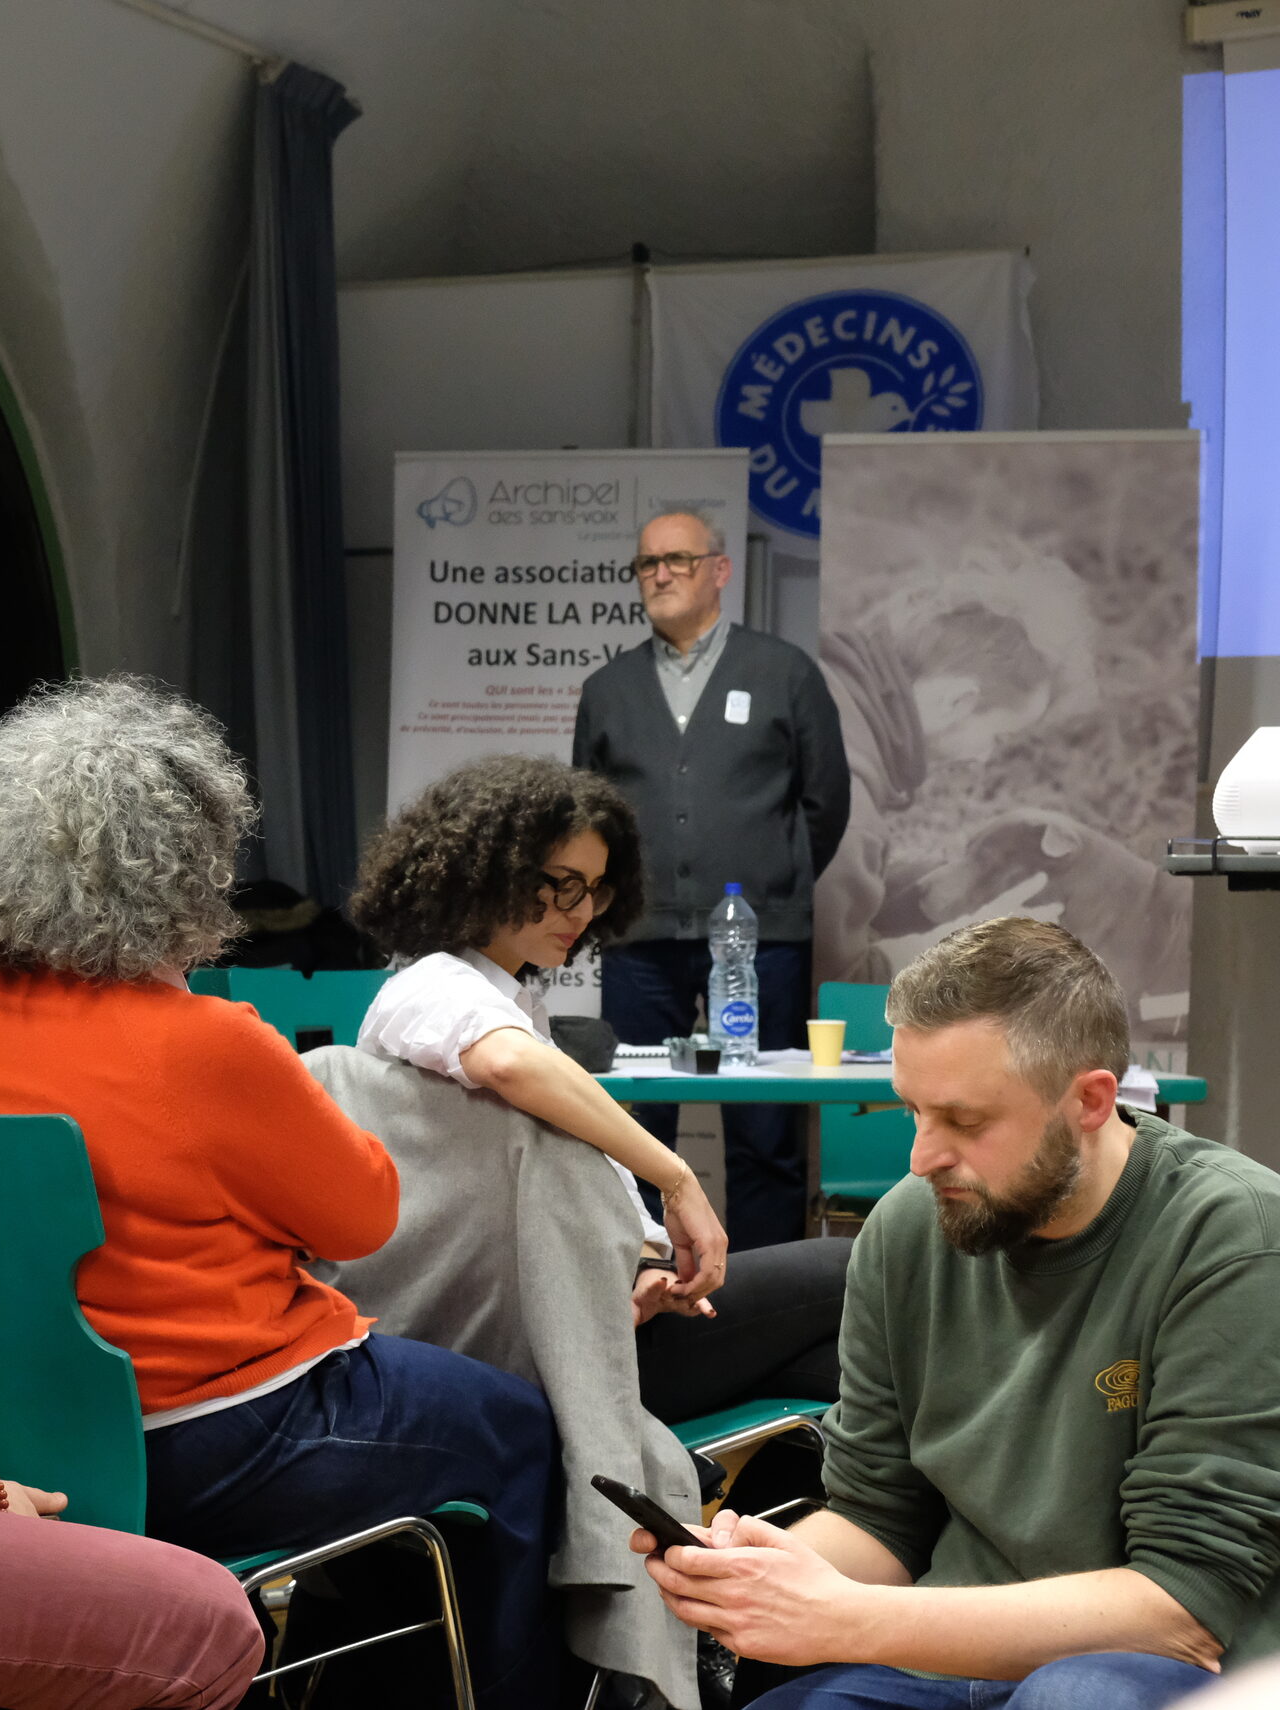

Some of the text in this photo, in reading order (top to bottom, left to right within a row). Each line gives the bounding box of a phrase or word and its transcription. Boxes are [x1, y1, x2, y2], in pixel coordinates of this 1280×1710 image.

[737, 310, 940, 421] MÉDECINS
[749, 444, 799, 499] DU
[488, 478, 620, 508] Archipel
[489, 509, 619, 526] des sans-voix
[430, 559, 636, 584] Une associatio
[433, 601, 647, 625] DONNE LA PAR
[467, 643, 623, 667] aux Sans-V
